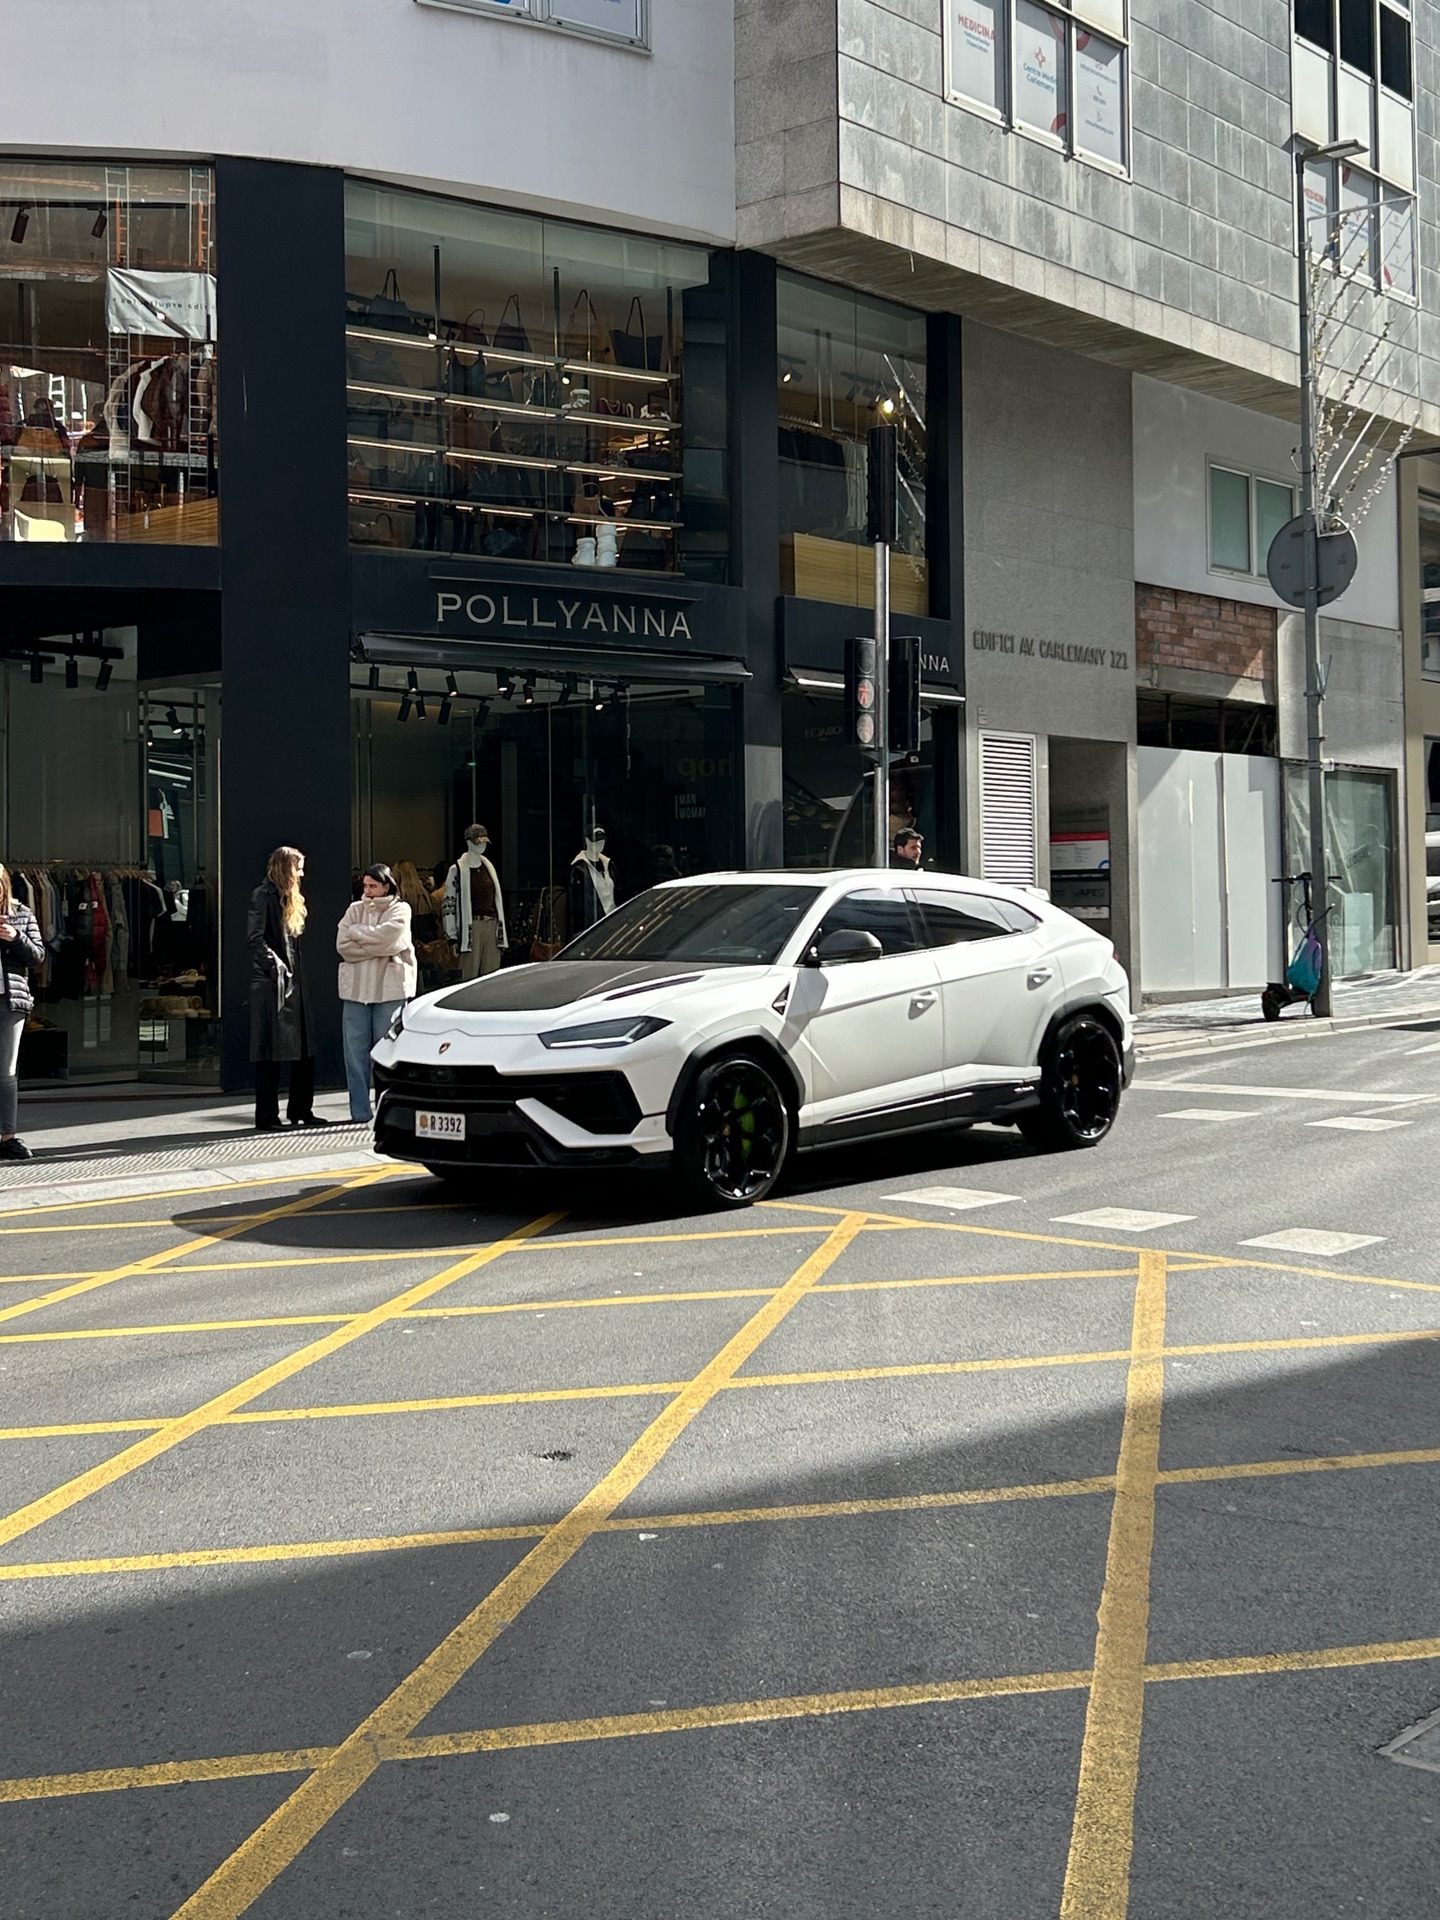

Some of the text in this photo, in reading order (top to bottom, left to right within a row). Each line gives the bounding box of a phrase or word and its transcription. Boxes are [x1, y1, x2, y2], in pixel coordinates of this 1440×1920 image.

[437, 592, 692, 640] POLLYANNA
[973, 630, 1014, 654] EDIFICI
[1039, 639, 1106, 667] CARLEMANY
[1110, 650, 1129, 670] 121
[438, 1116, 461, 1133] 3392
